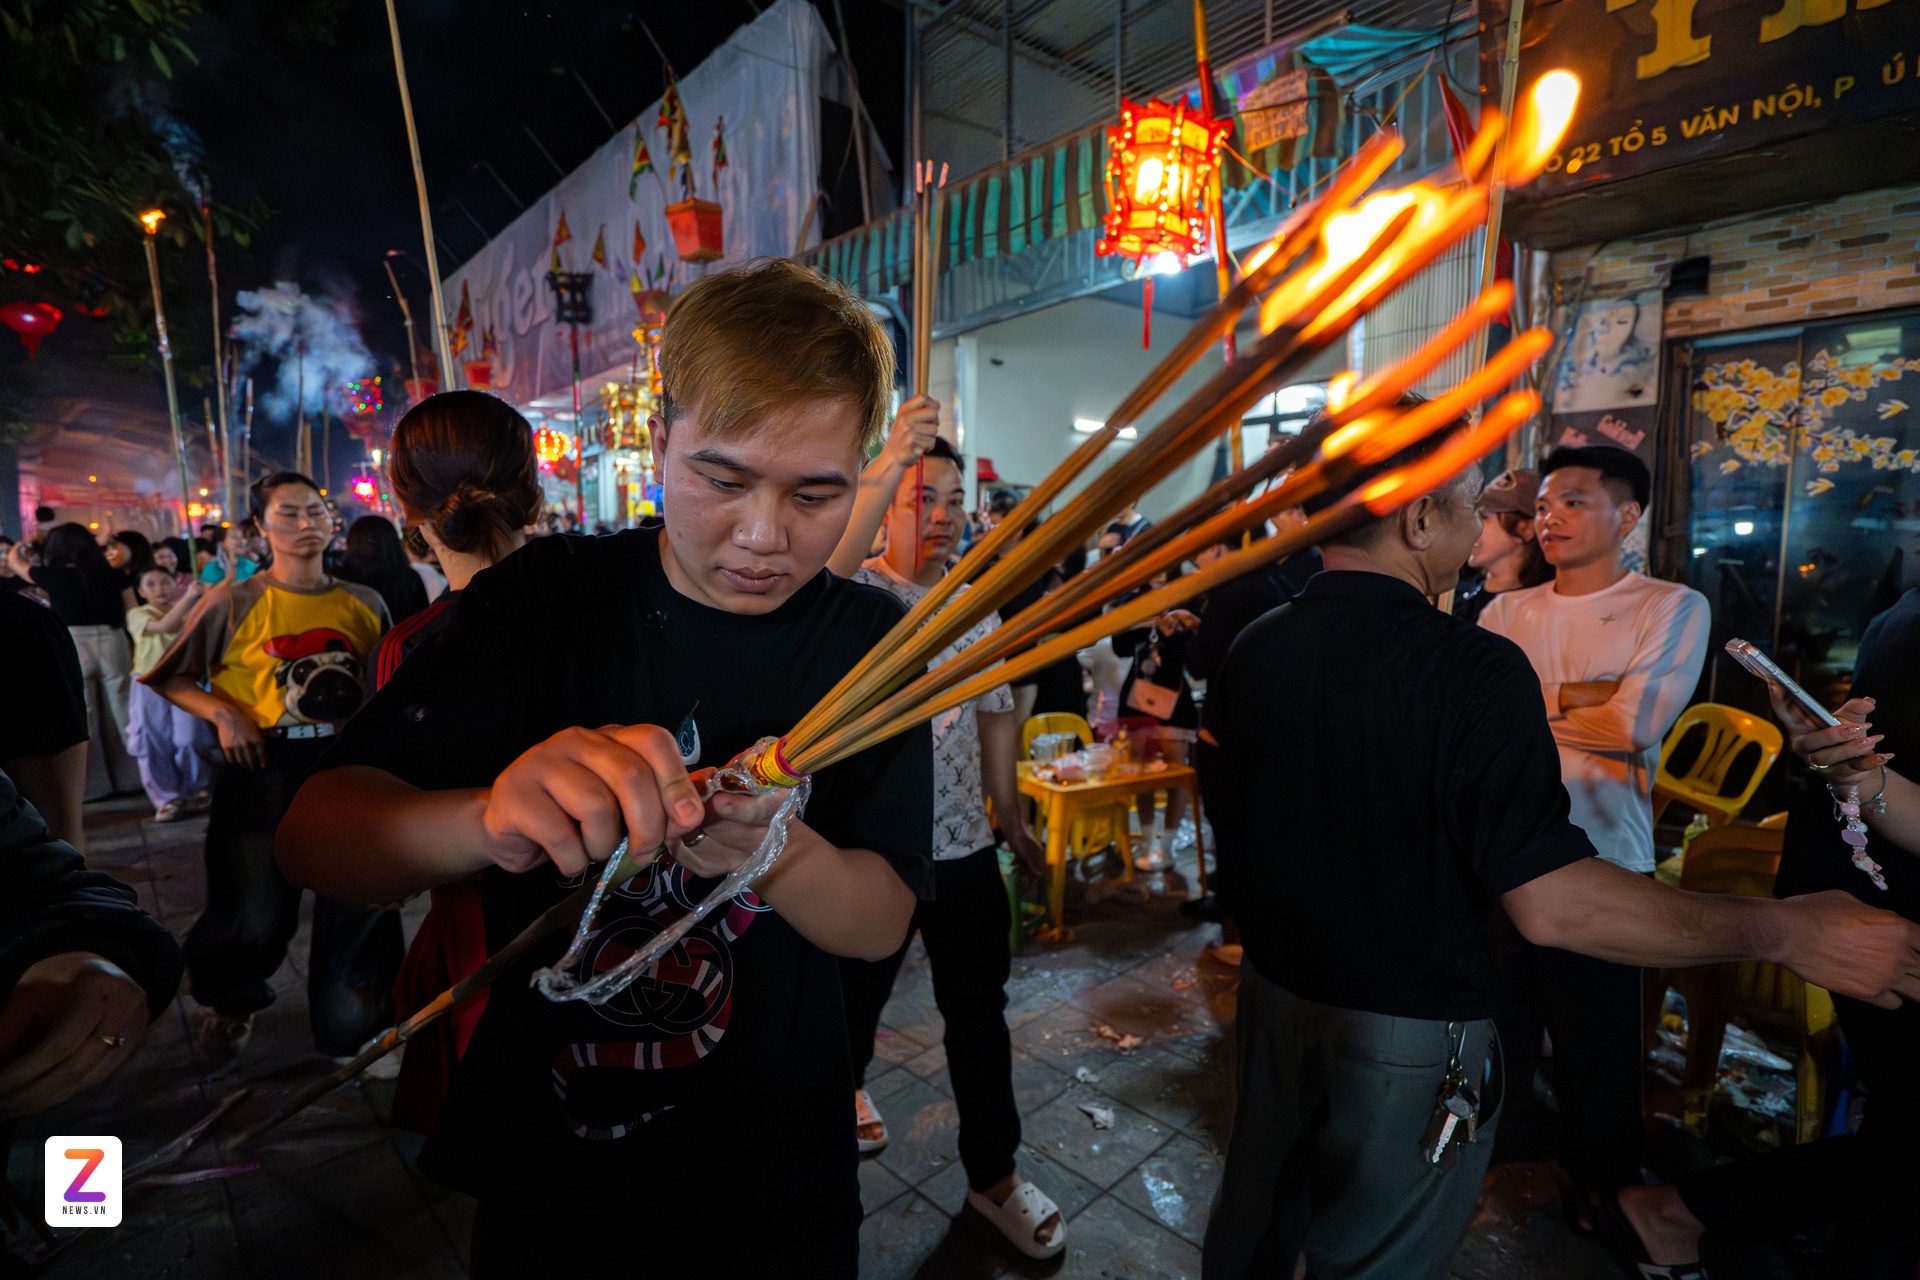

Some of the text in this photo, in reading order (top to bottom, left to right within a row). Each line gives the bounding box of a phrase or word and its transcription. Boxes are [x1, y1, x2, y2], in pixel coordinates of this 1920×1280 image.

[1609, 119, 1646, 156] TỔ
[1651, 126, 1668, 146] 5
[1680, 104, 1740, 139] VĂN
[1752, 83, 1822, 119] NỘI,
